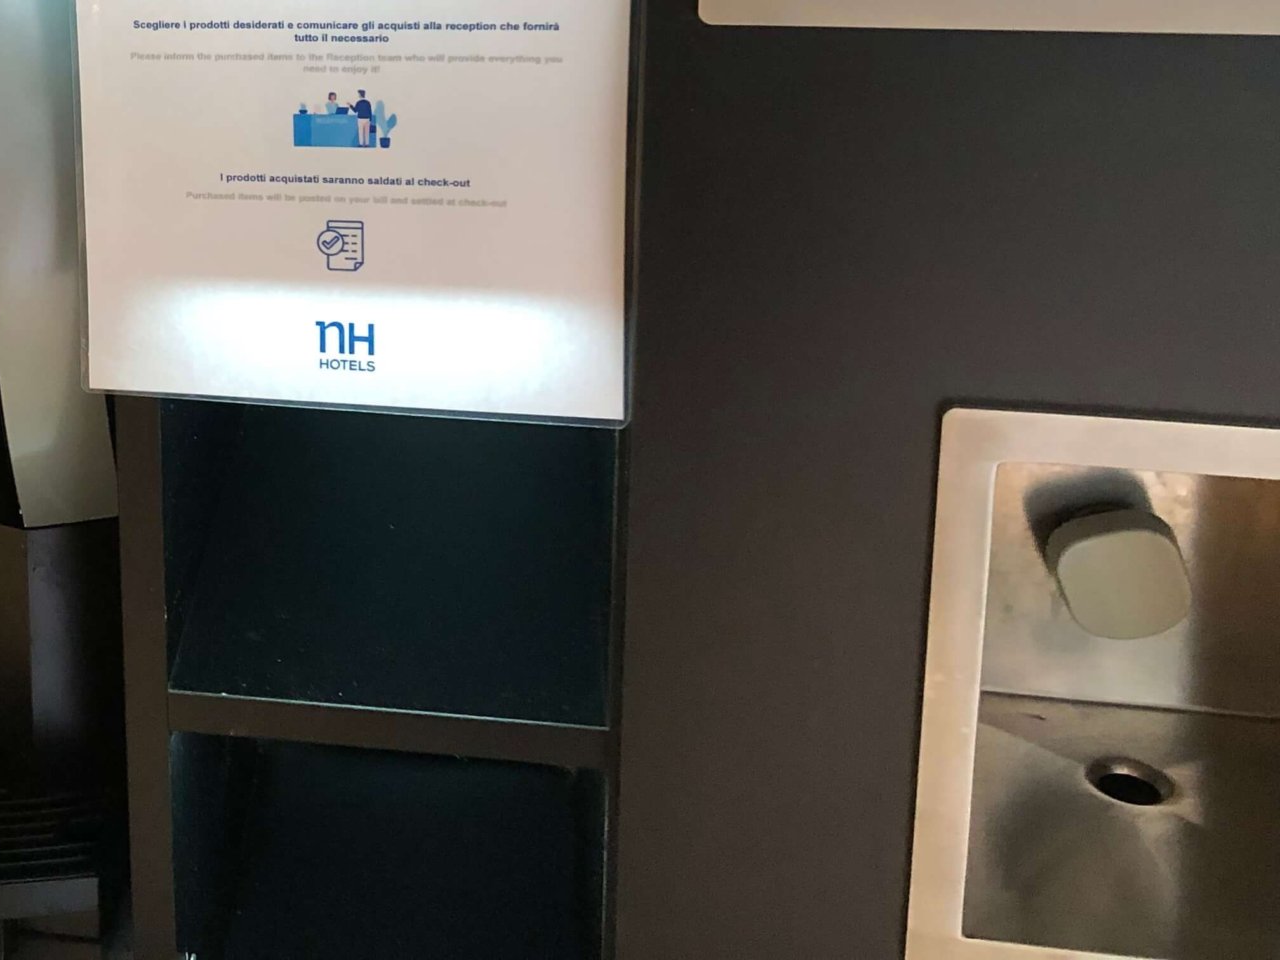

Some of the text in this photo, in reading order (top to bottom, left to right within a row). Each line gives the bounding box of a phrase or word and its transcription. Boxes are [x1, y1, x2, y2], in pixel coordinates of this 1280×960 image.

[133, 20, 181, 31] Scegliere
[189, 20, 230, 31] prodotti
[233, 20, 284, 29] desiderati
[296, 21, 358, 30] comunicare
[361, 21, 375, 32] gli
[377, 21, 420, 32] acquisti
[423, 21, 442, 30] alla
[445, 22, 497, 32] reception
[500, 22, 520, 31] che
[294, 33, 390, 43] tutto il necessario
[130, 52, 161, 61] Please
[227, 173, 266, 184] prodotti
[269, 174, 319, 185] acquistati
[322, 176, 365, 184] saranno
[367, 177, 402, 186] saldati
[405, 177, 414, 186] al
[417, 177, 470, 188] check-out
[186, 191, 235, 200] Purchased
[319, 359, 376, 372] HOTELS
